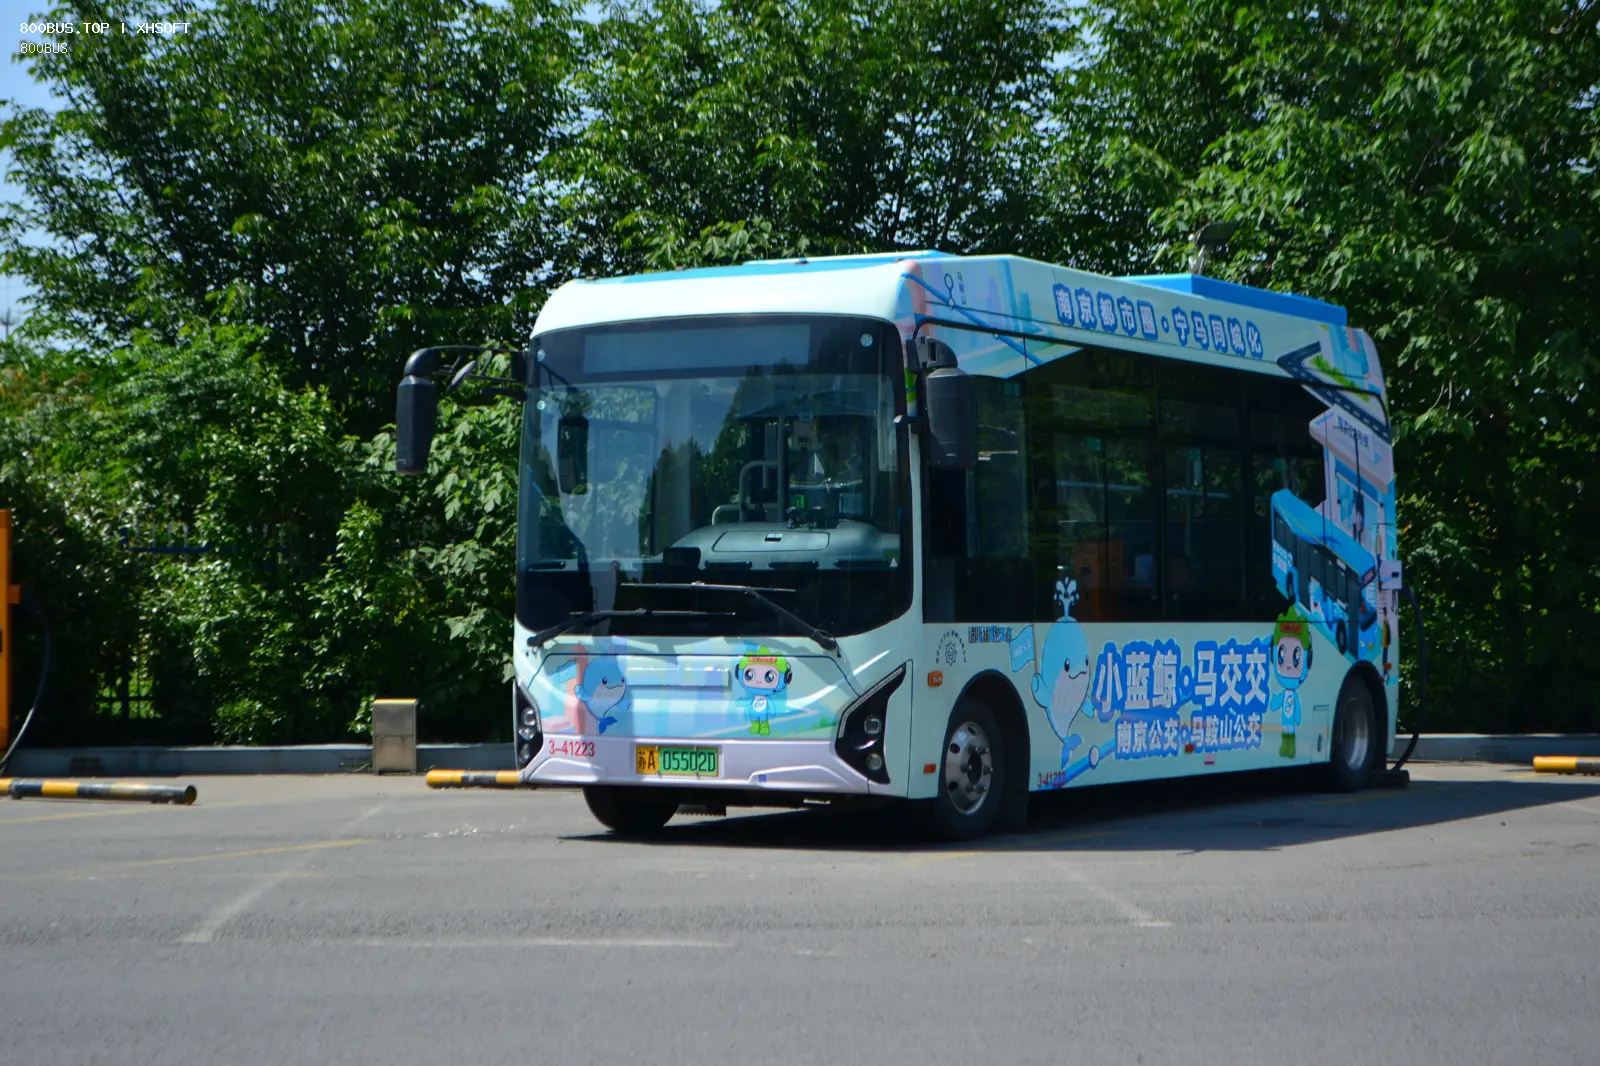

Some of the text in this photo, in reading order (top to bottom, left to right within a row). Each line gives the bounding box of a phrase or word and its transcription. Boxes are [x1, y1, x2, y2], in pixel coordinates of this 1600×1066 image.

[1095, 646, 1268, 713] 小蓝鲸·马交交
[548, 739, 596, 758] 3-41223
